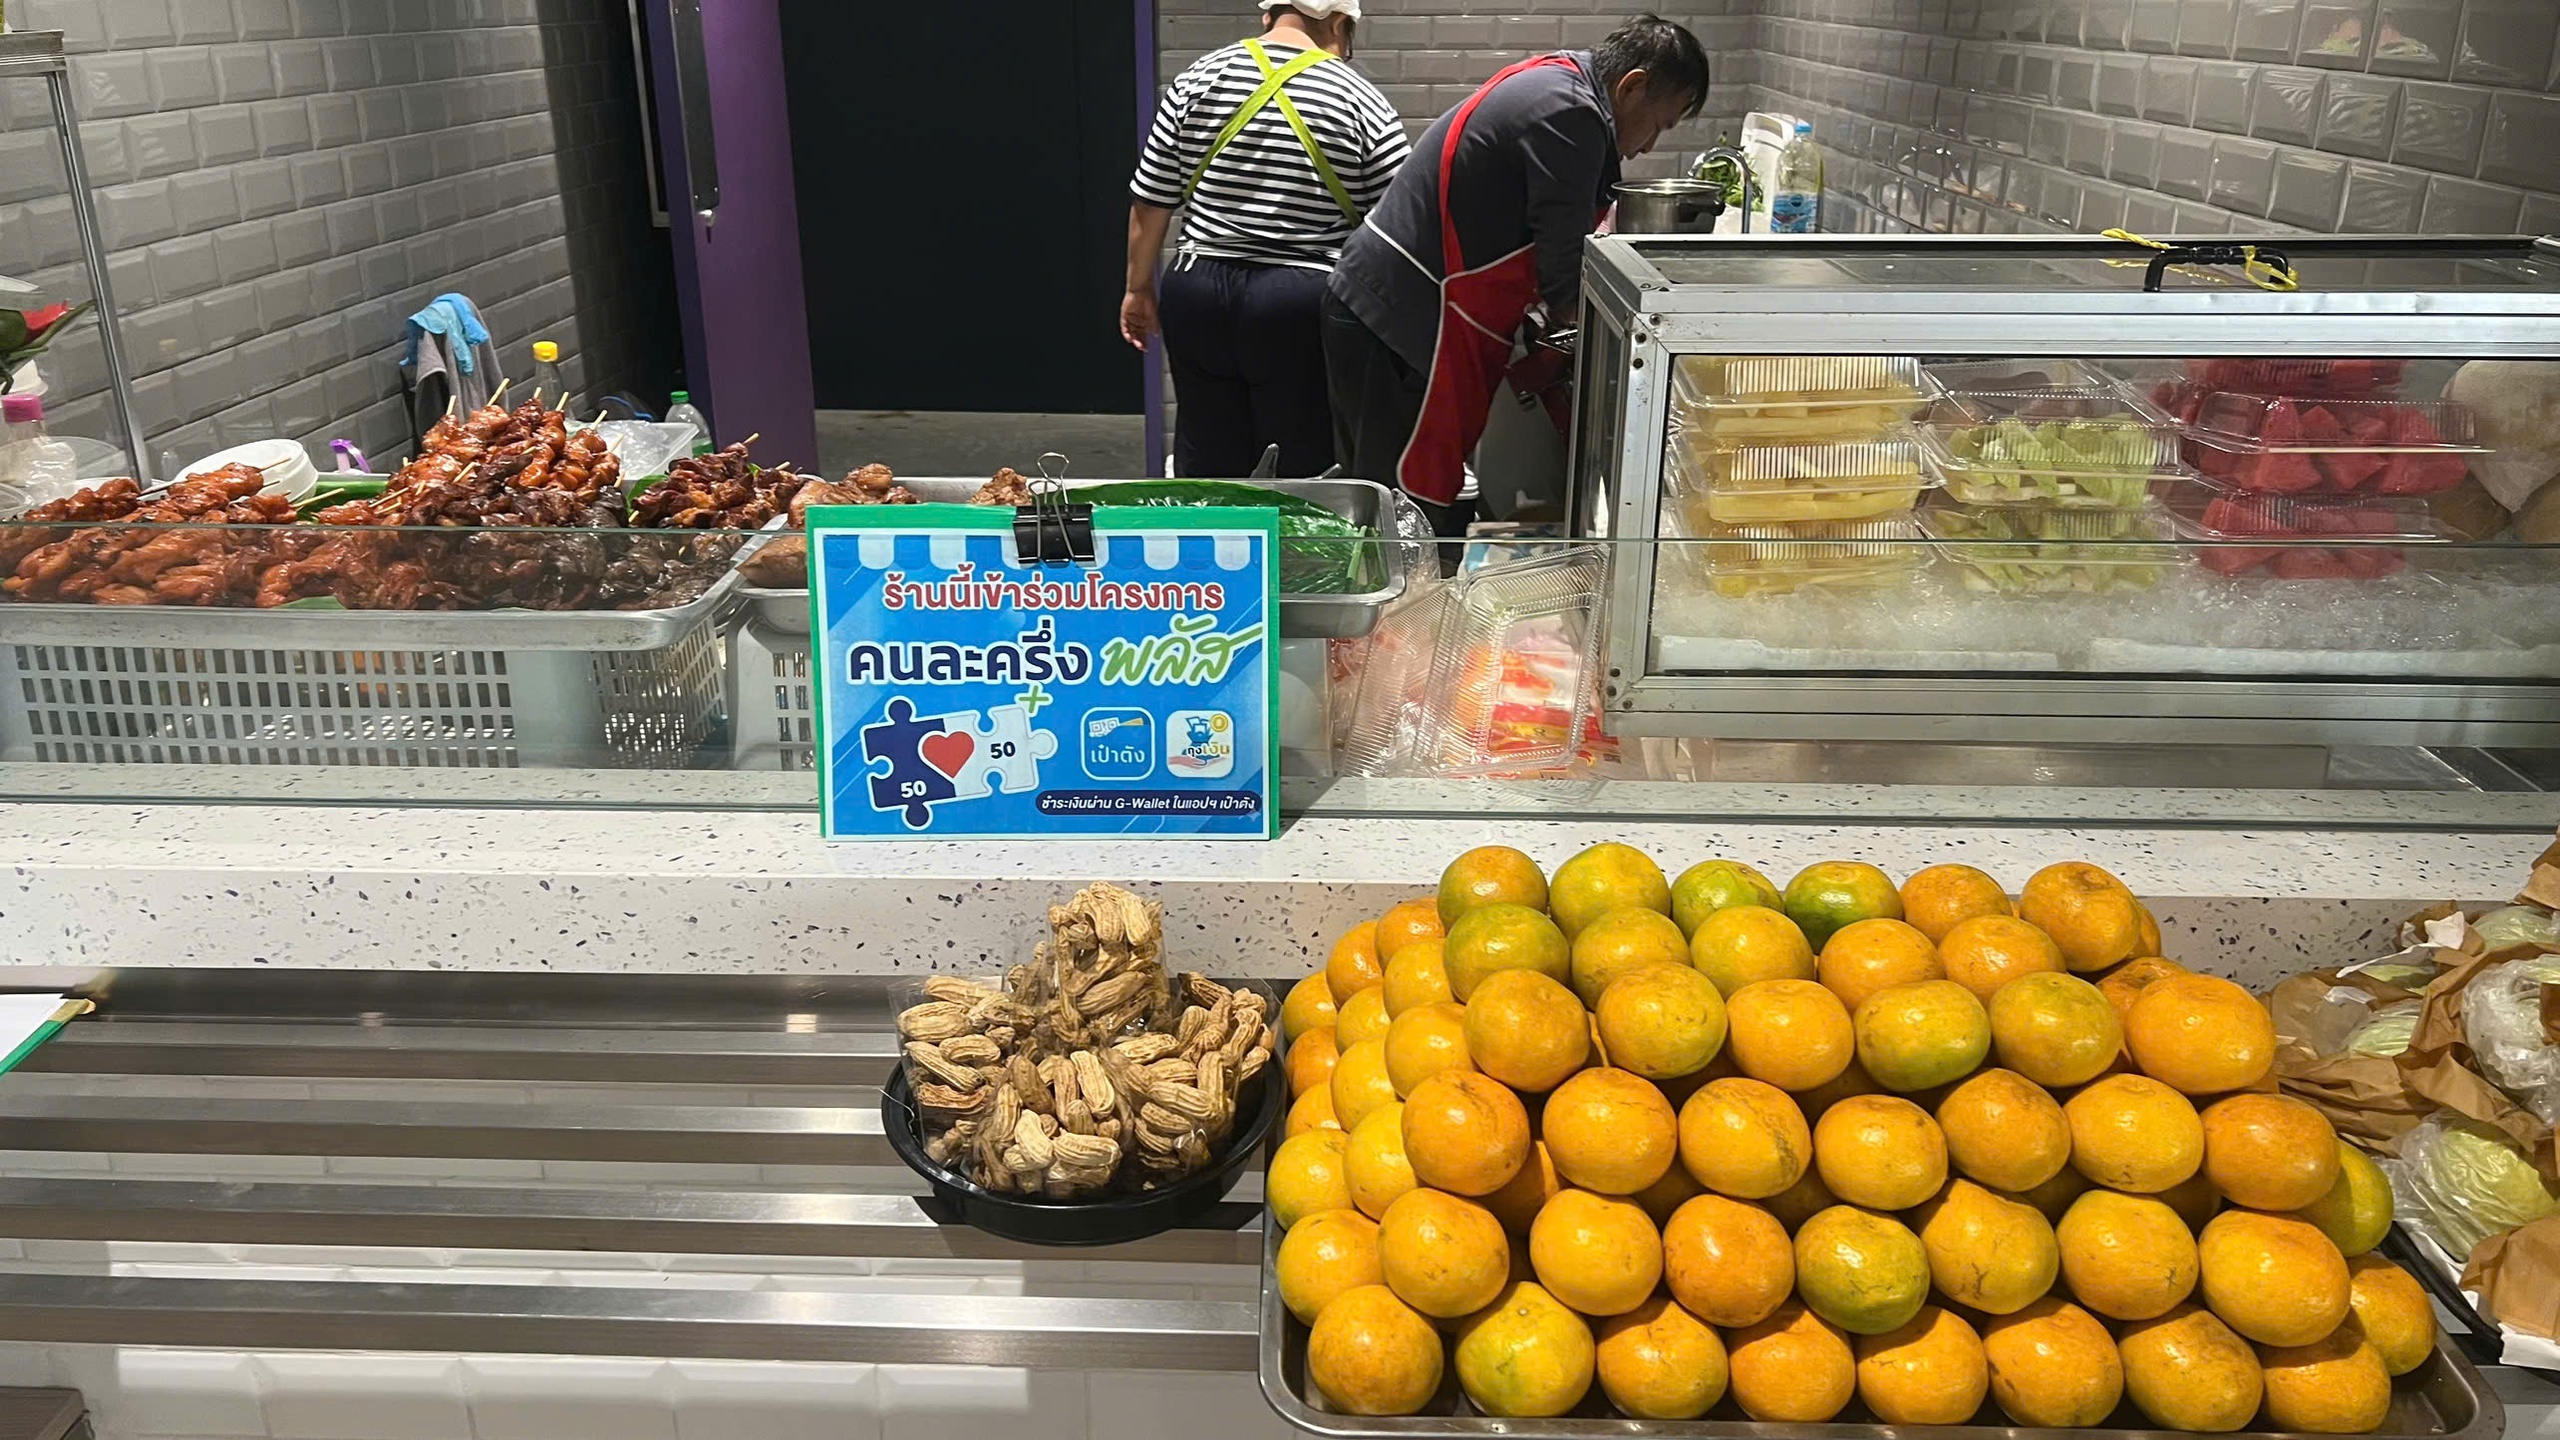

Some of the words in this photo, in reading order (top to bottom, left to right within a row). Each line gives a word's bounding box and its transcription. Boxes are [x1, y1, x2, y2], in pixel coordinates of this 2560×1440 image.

[884, 564, 1223, 609] ร้านนี้เข้าร่วมโครงการ
[851, 619, 1088, 681] คนละครึ่ง
[1103, 617, 1263, 682] พลัส
[990, 741, 1016, 759] 50
[1091, 743, 1146, 764] เป๋าตัง
[900, 780, 927, 798] 50
[1041, 795, 1112, 809] ชำระเงินผ่าน
[1115, 797, 1170, 809] G-Wallet
[1173, 795, 1216, 809] ในแอปฯ
[1220, 795, 1255, 809] เป๋าตัง
